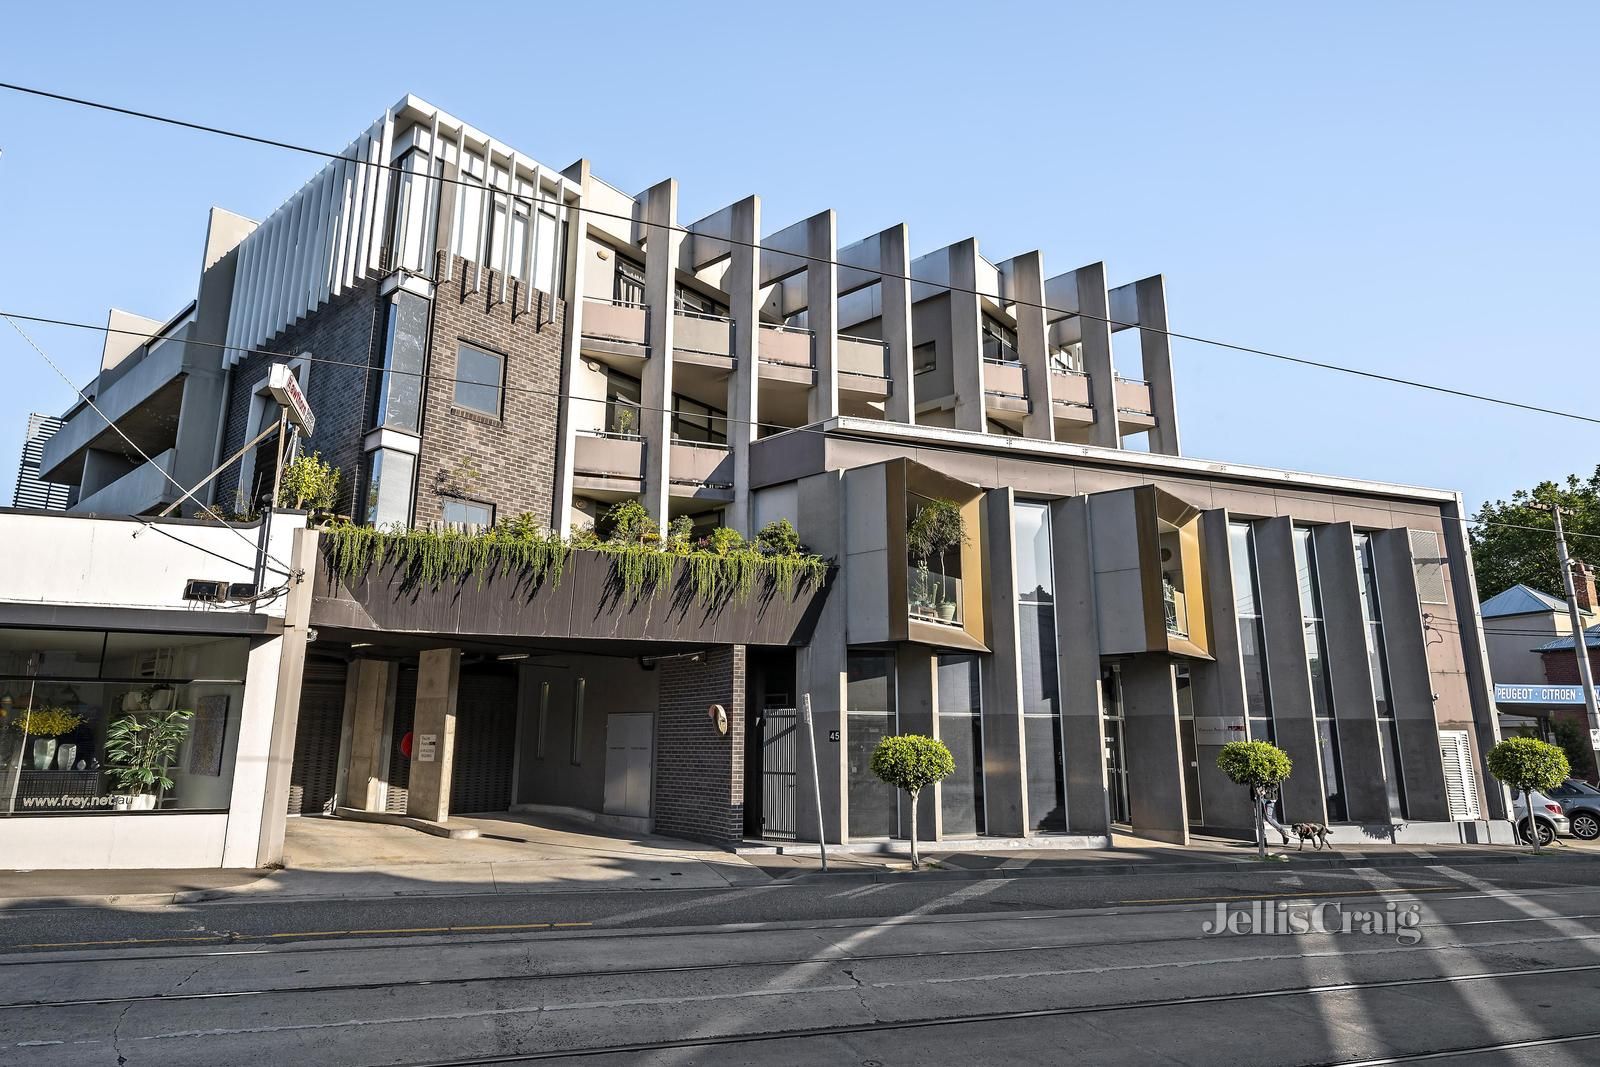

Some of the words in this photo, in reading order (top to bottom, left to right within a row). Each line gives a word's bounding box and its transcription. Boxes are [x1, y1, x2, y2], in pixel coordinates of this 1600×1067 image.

[1497, 688, 1533, 700] PEUGEOT
[1541, 688, 1576, 700] CITROEN
[829, 731, 840, 741] 45
